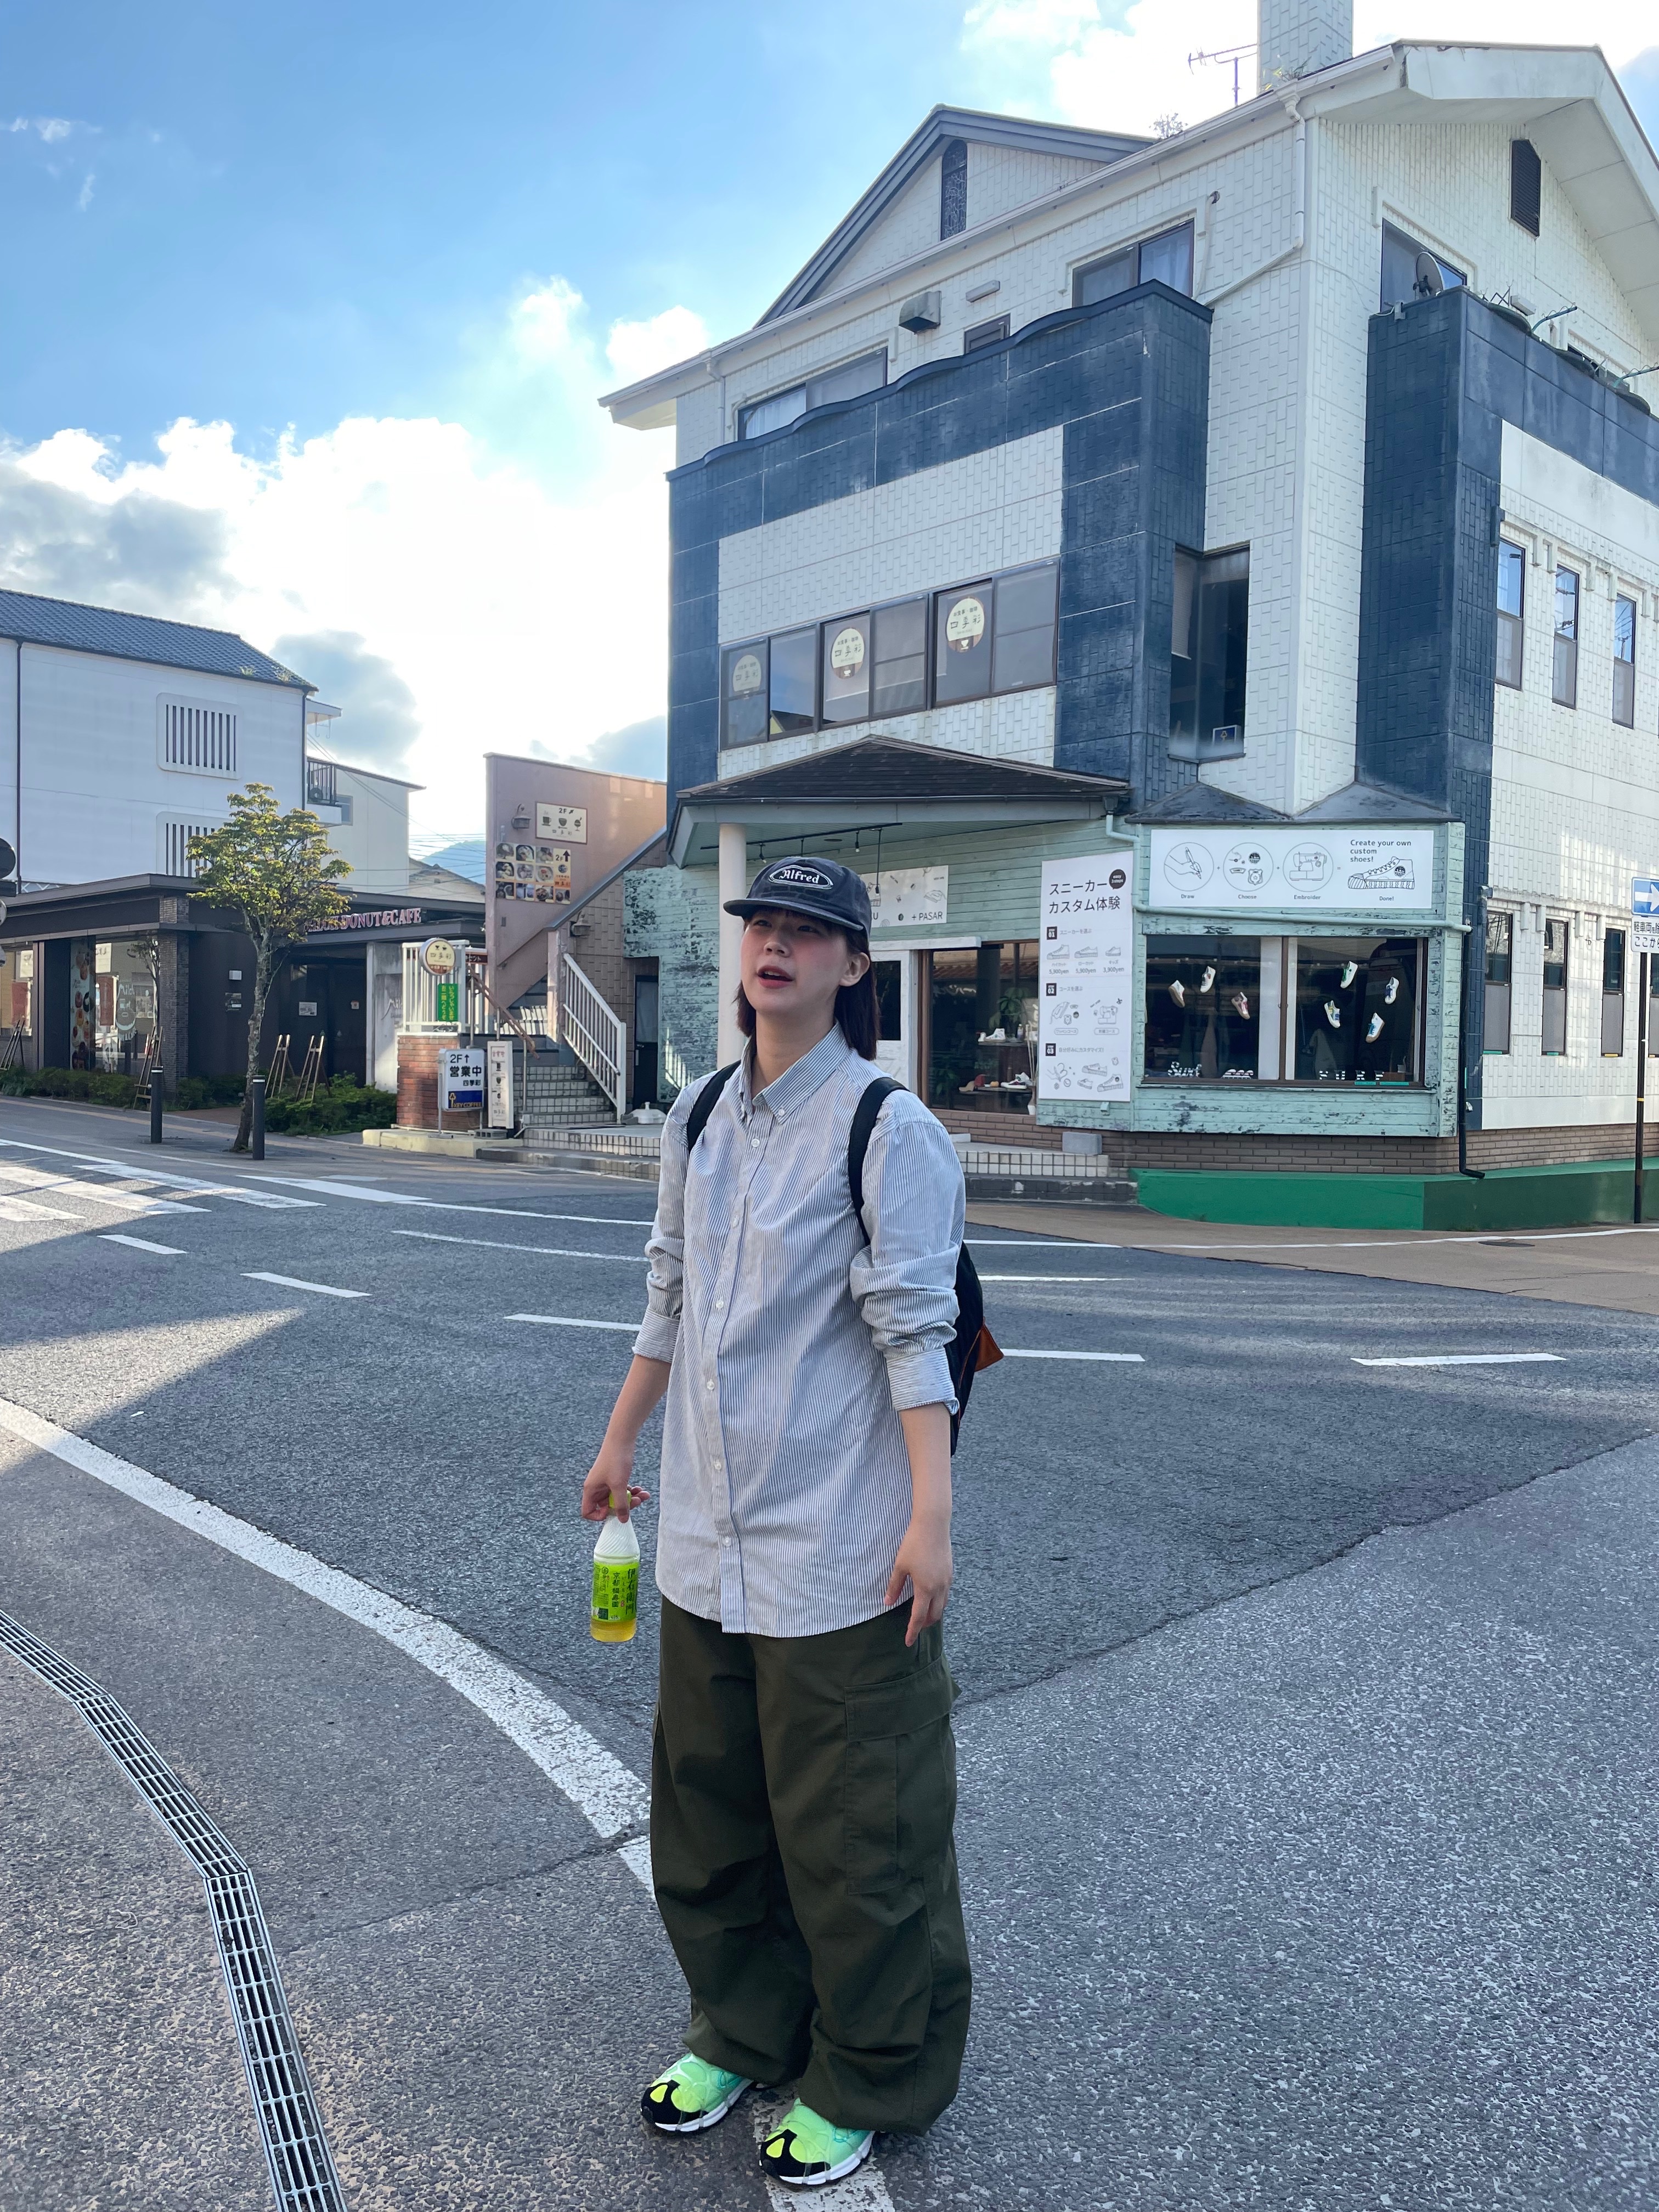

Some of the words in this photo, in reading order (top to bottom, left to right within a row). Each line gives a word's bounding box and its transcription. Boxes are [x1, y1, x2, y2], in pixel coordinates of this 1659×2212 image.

[779, 870, 820, 884] Alfred
[1049, 880, 1107, 895] スニーカー
[1049, 895, 1120, 914] カスタム体験
[341, 907, 421, 930] DONUT&CAFE
[919, 911, 943, 921] PASAR
[450, 1054, 462, 1063] 2F
[450, 1065, 482, 1077] 営業中
[1167, 1061, 1202, 1077] Surf
